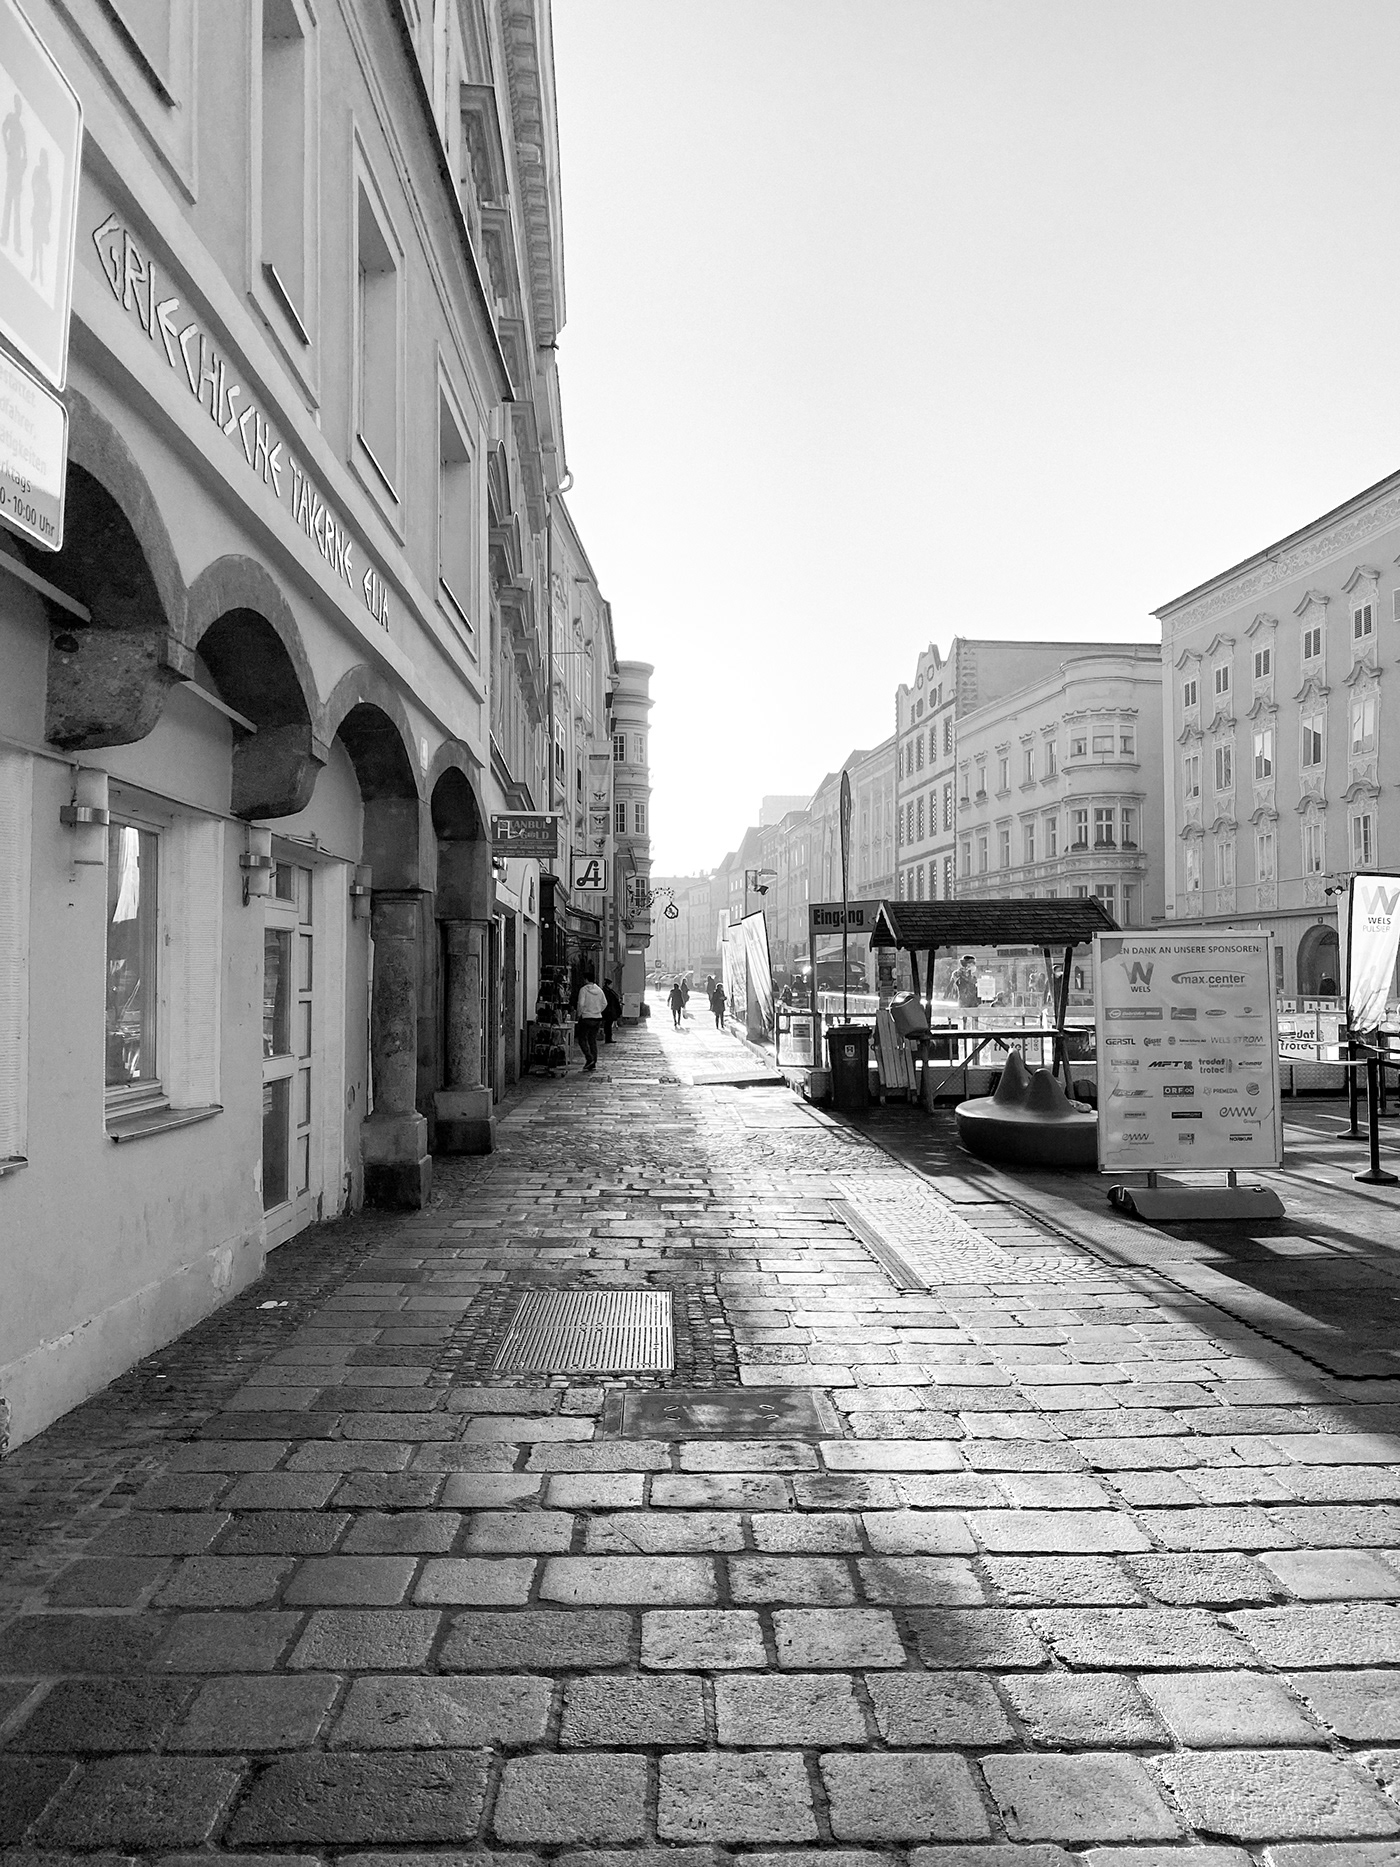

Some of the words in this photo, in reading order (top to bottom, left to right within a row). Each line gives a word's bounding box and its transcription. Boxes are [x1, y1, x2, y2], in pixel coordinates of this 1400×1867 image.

[93, 213, 282, 498] GRIECHISCHE
[289, 456, 353, 588] TAVERNE
[363, 567, 390, 632] ELIA
[39, 515, 56, 537] Uhr
[1367, 917, 1392, 925] WELS
[1208, 945, 1262, 953] SPONSOREN:
[1180, 974, 1245, 984] max.center
[1105, 1038, 1136, 1046] GERSTL
[1164, 1087, 1184, 1095] ORF
